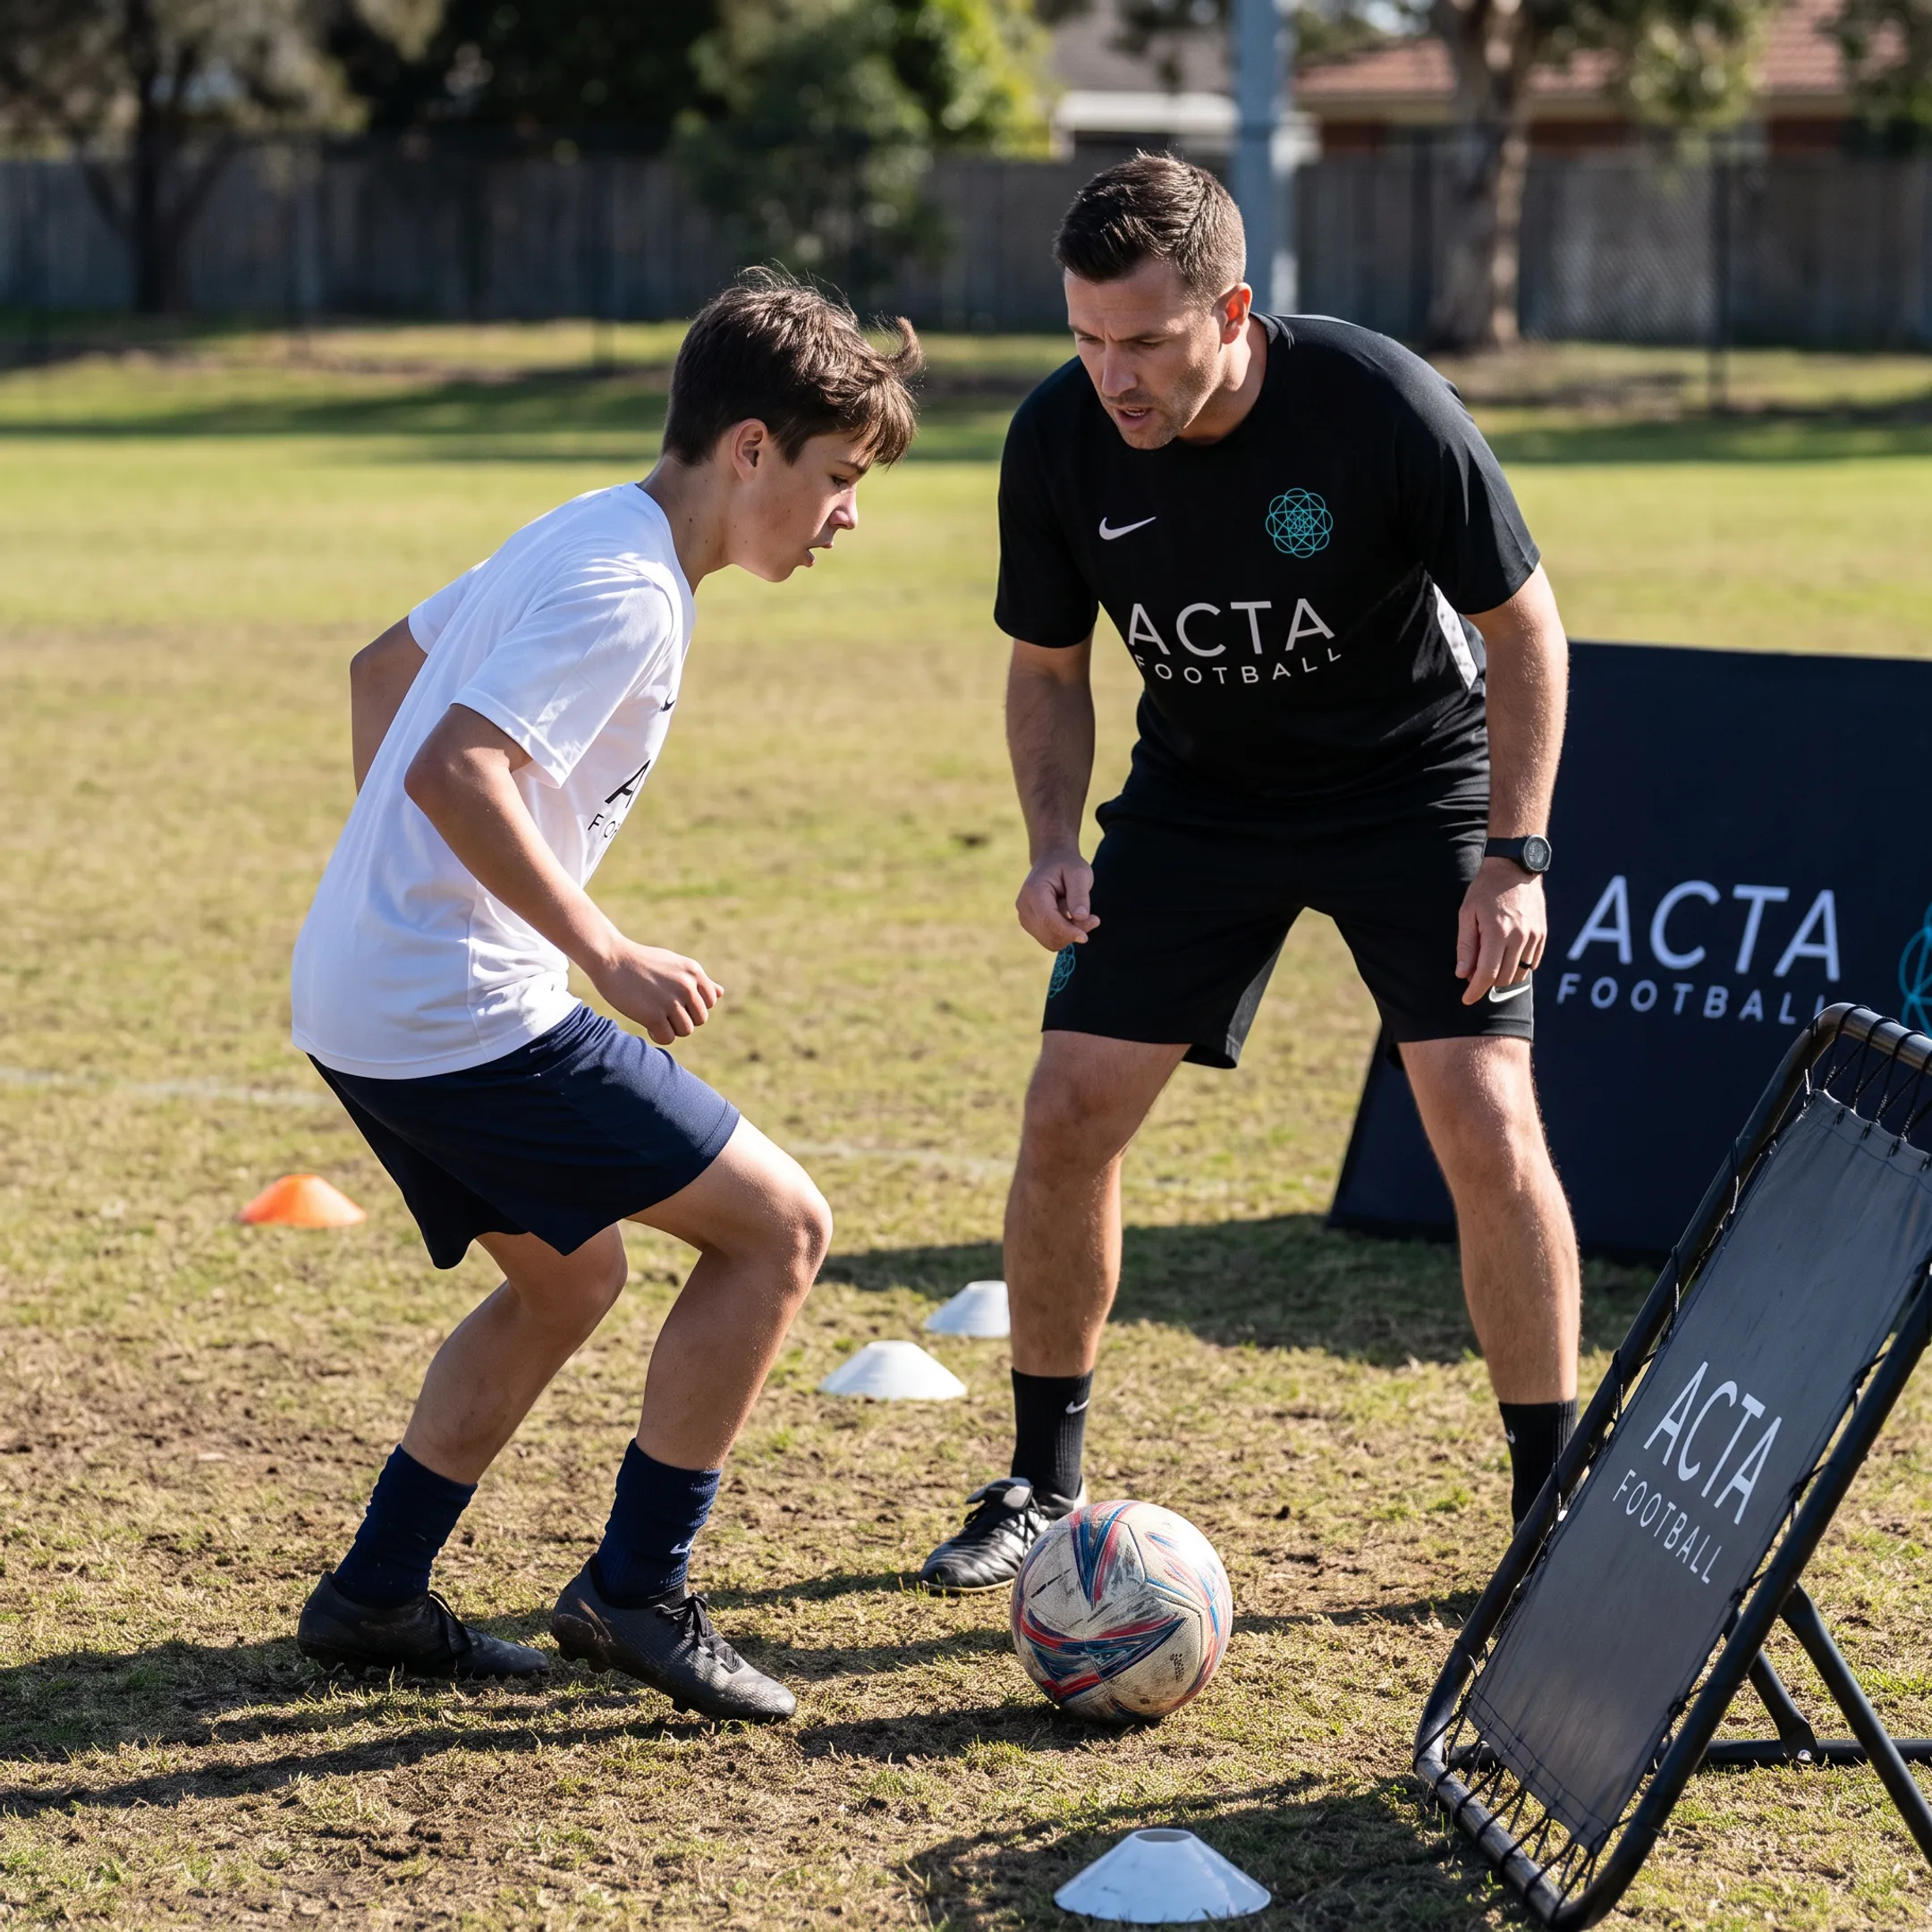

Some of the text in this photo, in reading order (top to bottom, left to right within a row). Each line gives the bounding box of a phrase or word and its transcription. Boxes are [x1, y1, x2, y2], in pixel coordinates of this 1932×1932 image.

[1128, 597, 1335, 657] ACTA
[1134, 648, 1342, 684] FOOTBALL
[1566, 874, 1841, 982] ACTA
[1643, 1360, 1782, 1525] ACTA
[1612, 1468, 1722, 1584] FOOTBALL
